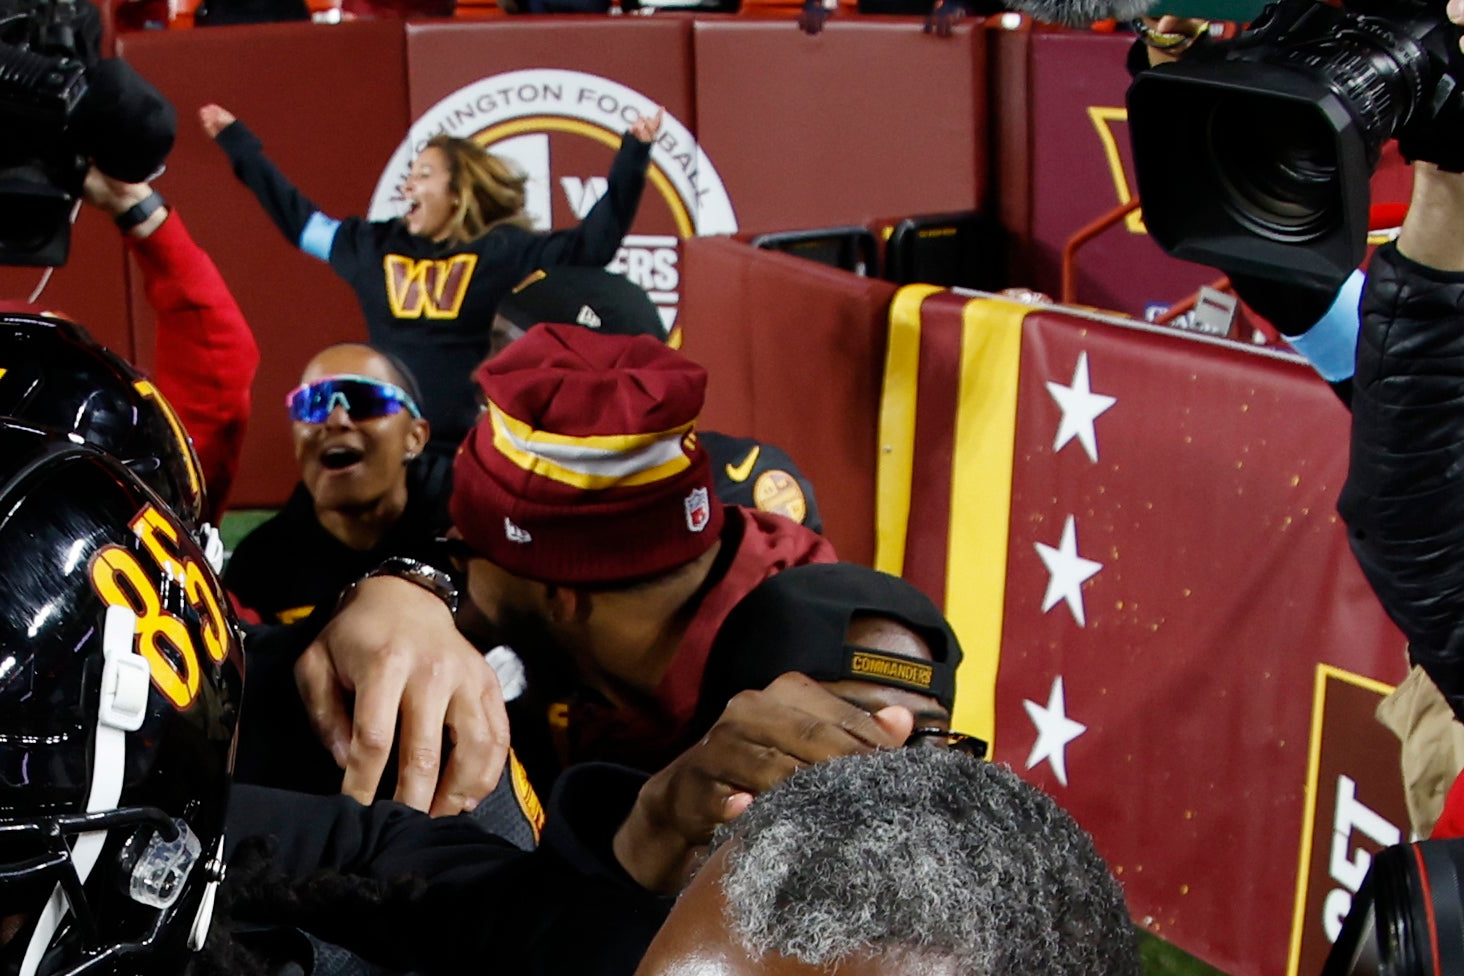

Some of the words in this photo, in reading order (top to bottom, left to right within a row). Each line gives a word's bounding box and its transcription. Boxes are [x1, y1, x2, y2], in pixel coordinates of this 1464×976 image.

[578, 88, 710, 207] FOOBALL
[88, 501, 230, 712] 85
[851, 655, 933, 684] COMMANDERS
